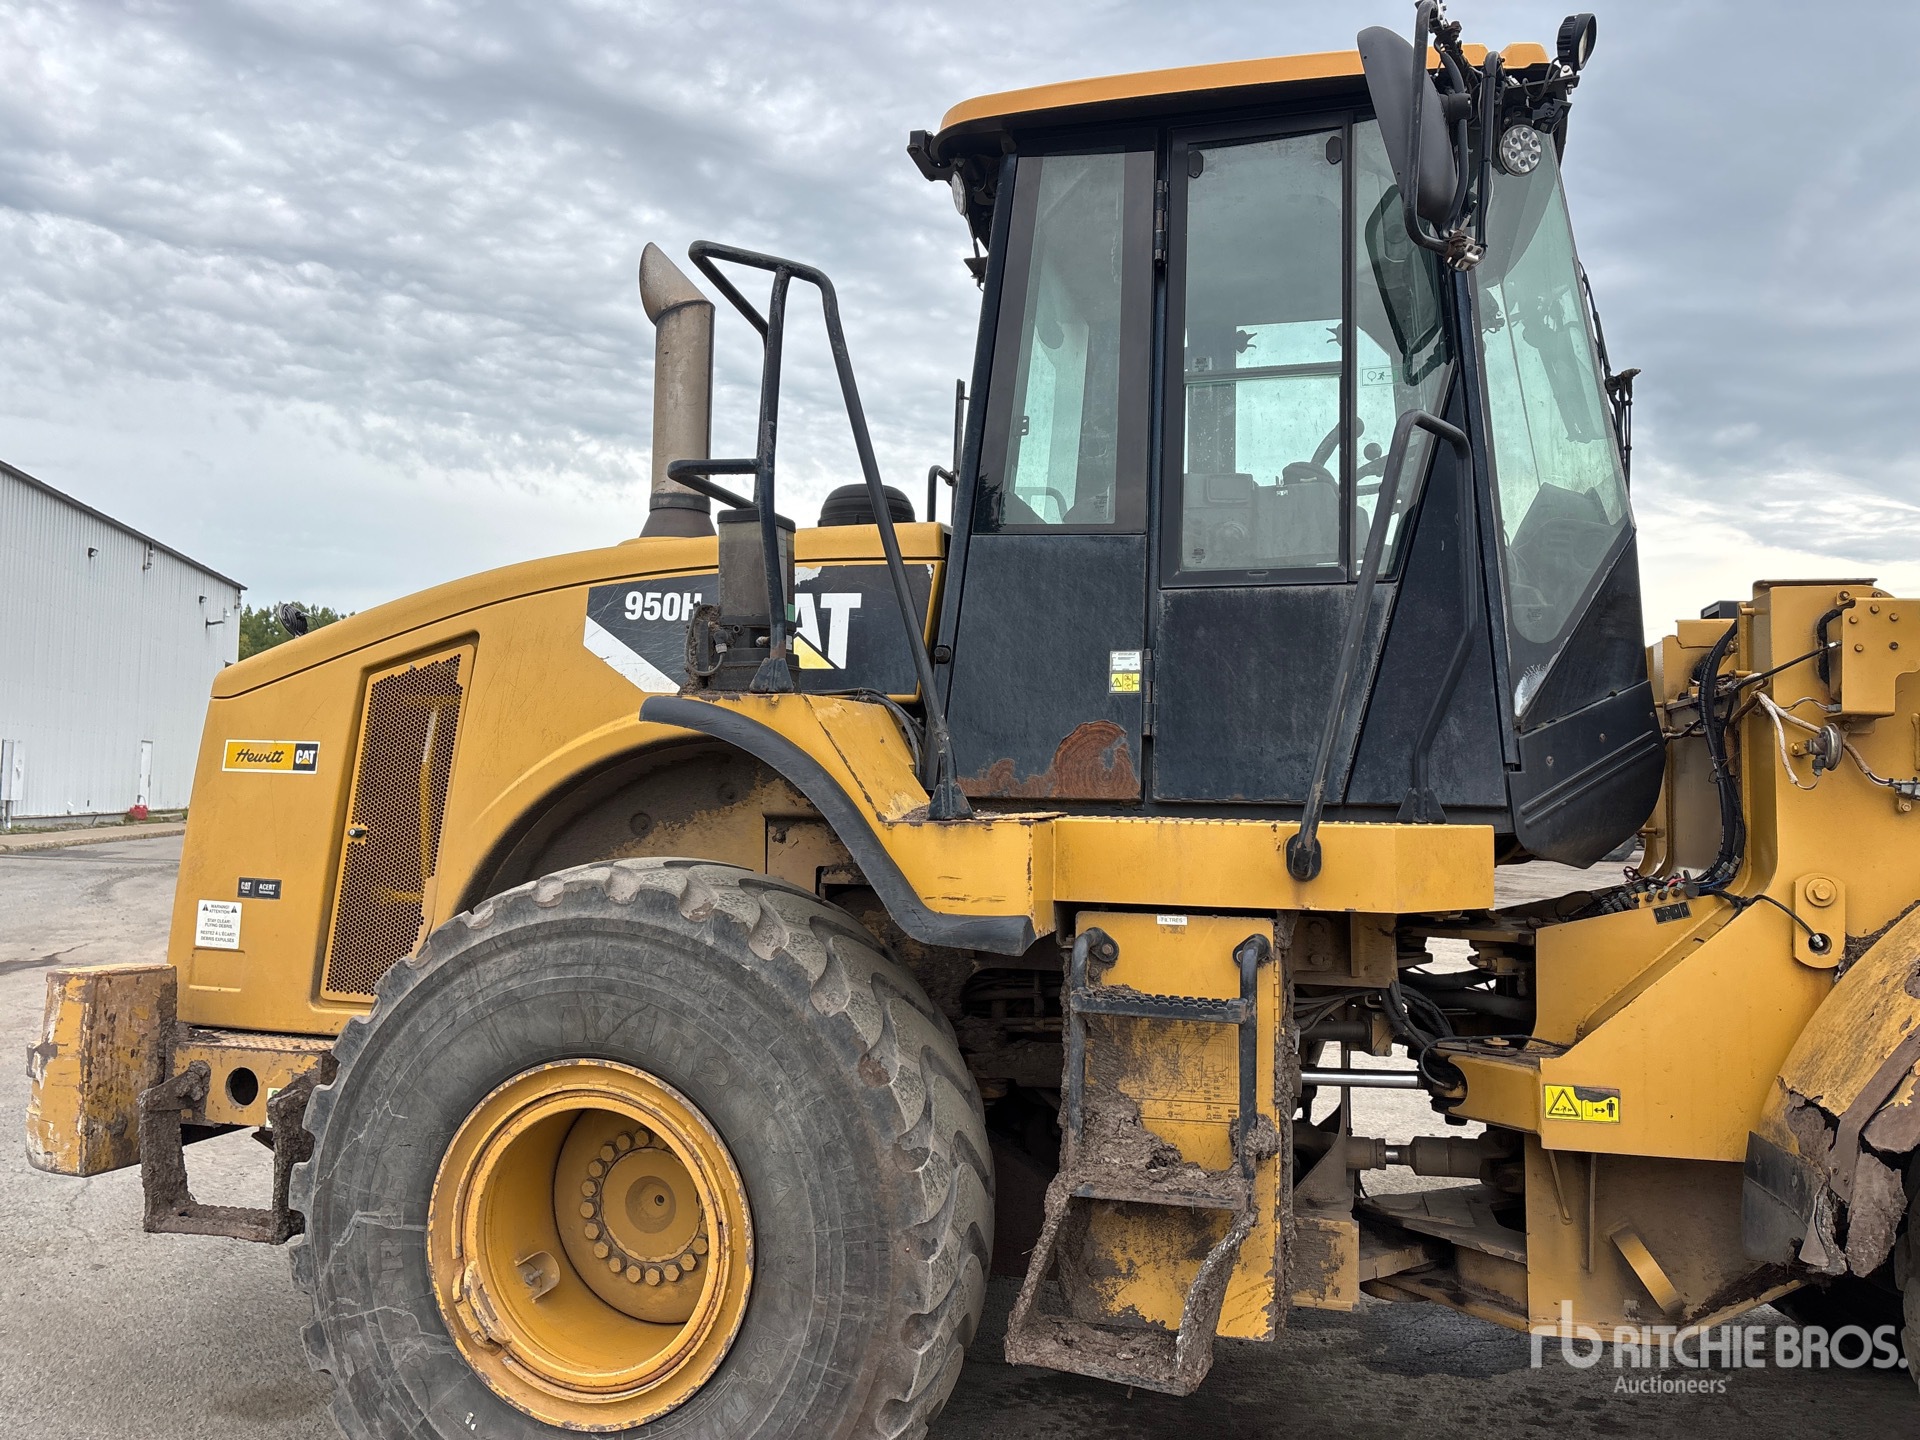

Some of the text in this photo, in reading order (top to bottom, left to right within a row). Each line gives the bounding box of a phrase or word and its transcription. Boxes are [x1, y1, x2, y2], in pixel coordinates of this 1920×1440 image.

[234, 748, 315, 765] Hewitt CAT
[240, 881, 251, 890] CAT
[258, 883, 276, 891] ACERT
